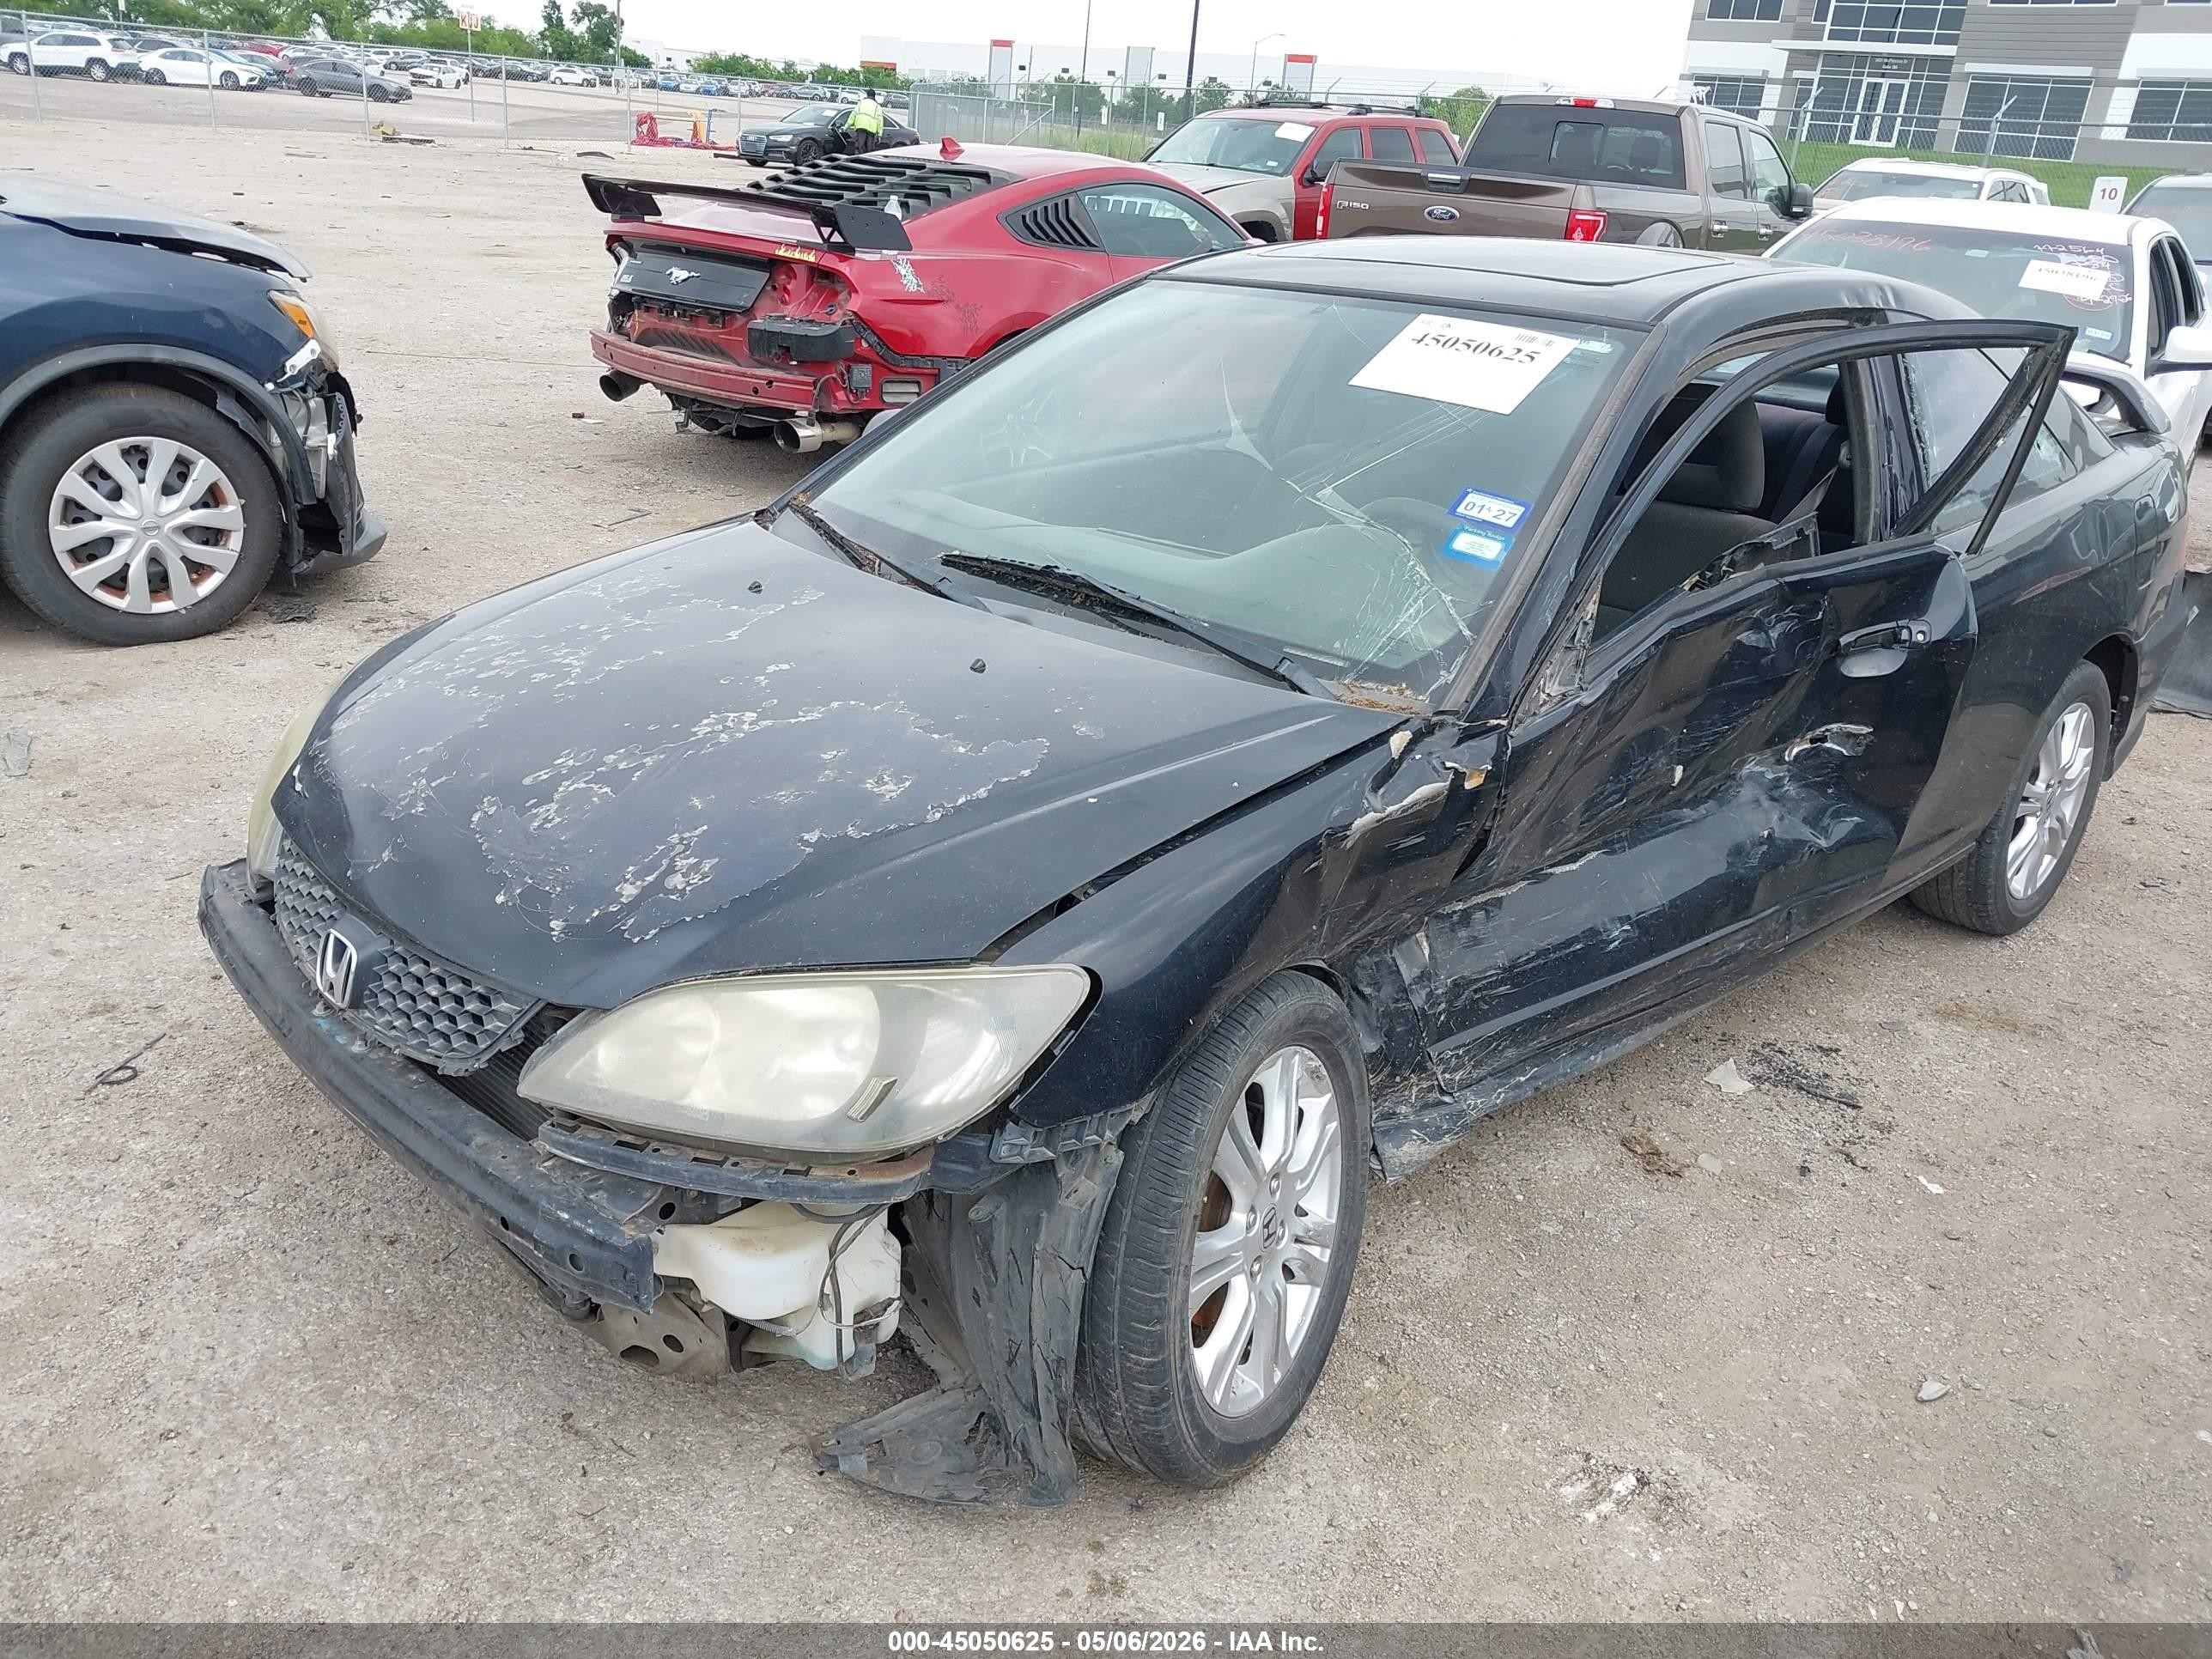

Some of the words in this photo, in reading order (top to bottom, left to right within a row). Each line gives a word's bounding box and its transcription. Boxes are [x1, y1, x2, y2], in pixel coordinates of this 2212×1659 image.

[2100, 187, 2118, 201] 10
[1411, 331, 1542, 364] 45050625
[1463, 501, 1486, 514] 01
[1492, 508, 1517, 522] 27
